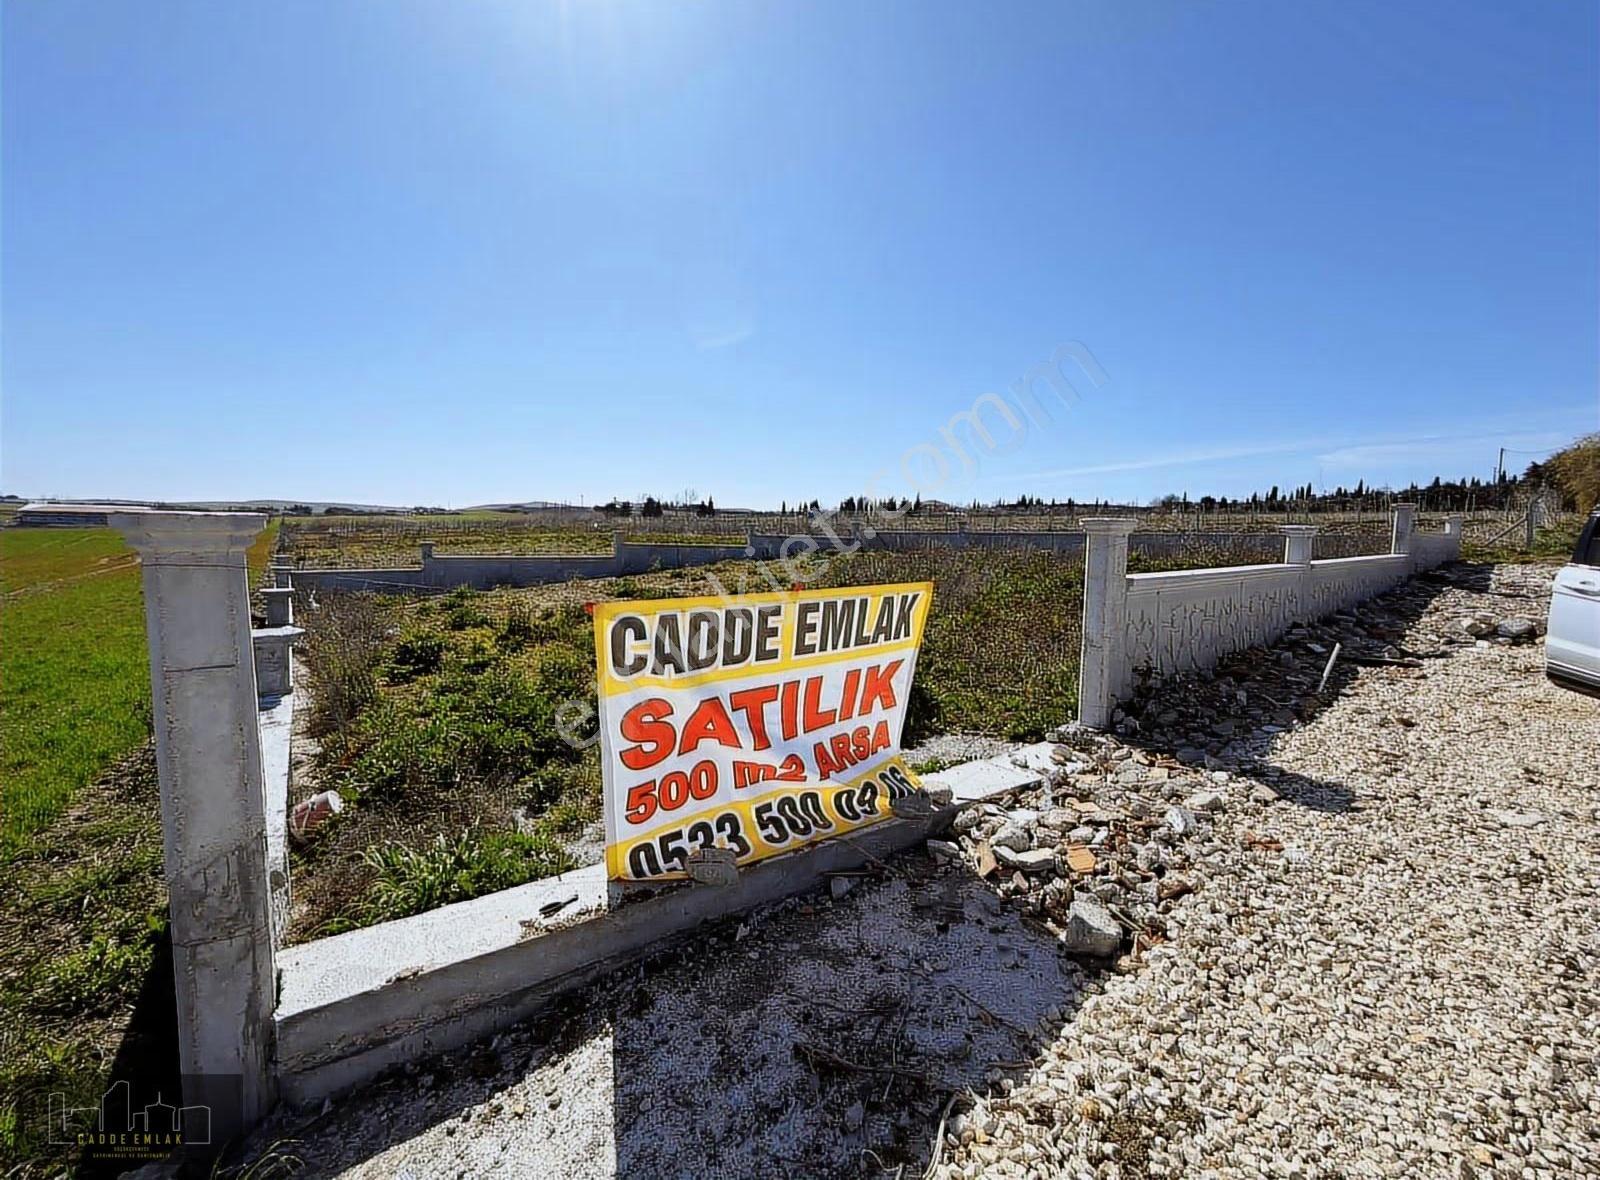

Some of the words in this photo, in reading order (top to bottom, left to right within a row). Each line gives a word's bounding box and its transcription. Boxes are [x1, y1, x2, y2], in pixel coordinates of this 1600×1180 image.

[610, 604, 783, 677] CADDE
[793, 592, 921, 656] EMLAK
[618, 658, 905, 771] SATILIK
[624, 760, 720, 825] 500
[732, 753, 808, 790] m2
[813, 720, 892, 781] ARSA
[754, 791, 834, 844] 500
[834, 780, 879, 822] 09
